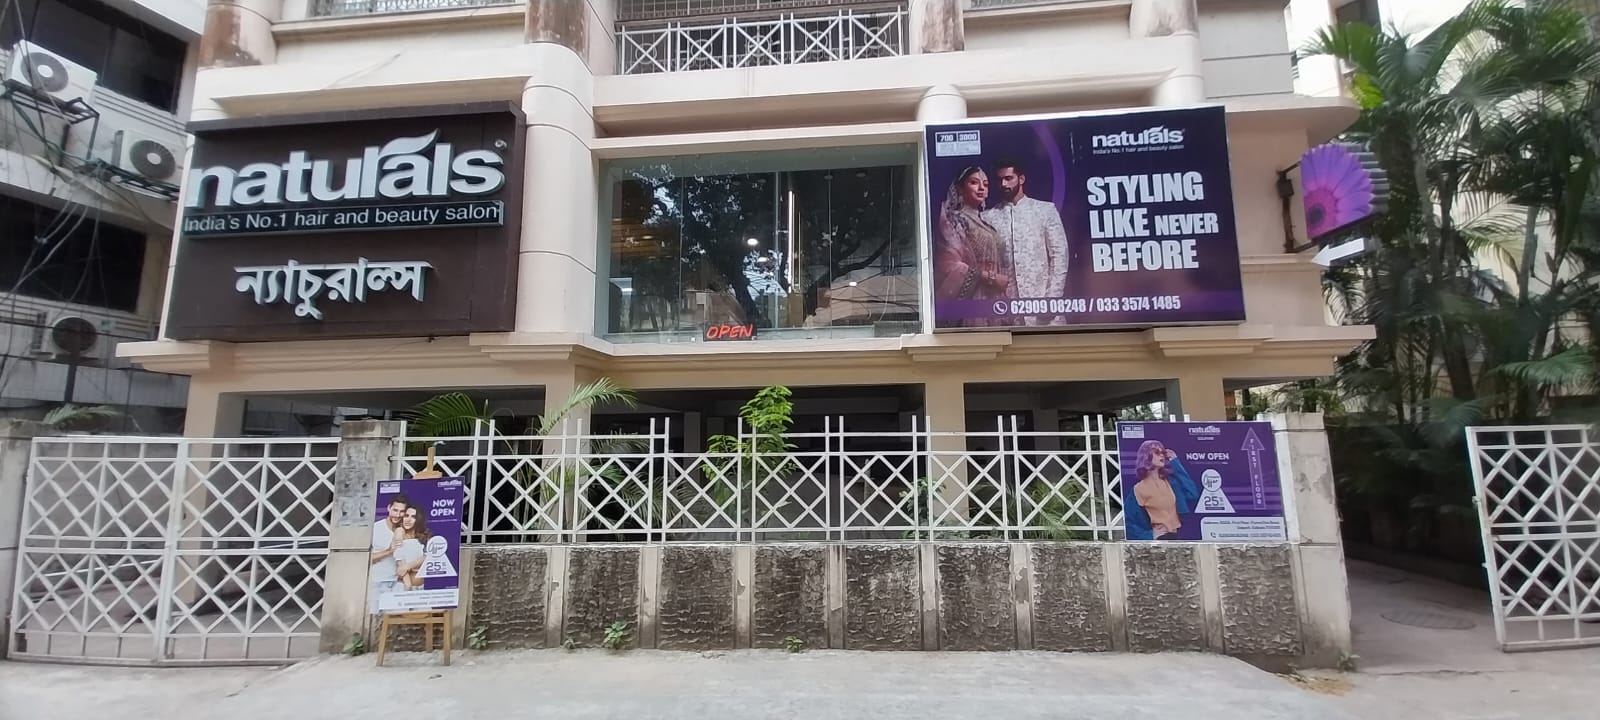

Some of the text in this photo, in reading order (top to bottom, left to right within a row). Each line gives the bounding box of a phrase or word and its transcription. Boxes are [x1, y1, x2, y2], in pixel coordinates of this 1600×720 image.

[1092, 125, 1184, 147] naturals
[184, 128, 506, 208] naturals
[1086, 171, 1204, 206] STYLING
[184, 214, 240, 232] India's
[294, 209, 328, 226] hair
[334, 206, 369, 225] and
[375, 205, 439, 226] beauty
[445, 203, 498, 220] salon
[1089, 207, 1219, 239] LIKE NEVER
[1091, 239, 1200, 273] BEFORE
[1010, 299, 1048, 315] 62909
[1049, 297, 1086, 313] 08248
[1096, 297, 1120, 312] 033
[1122, 296, 1149, 311] 3574
[1151, 295, 1181, 310] 1485
[706, 323, 753, 339] OPEN
[1185, 452, 1230, 460] NOW OPEN
[430, 508, 455, 517] OPEN
[432, 499, 455, 508] NOW
